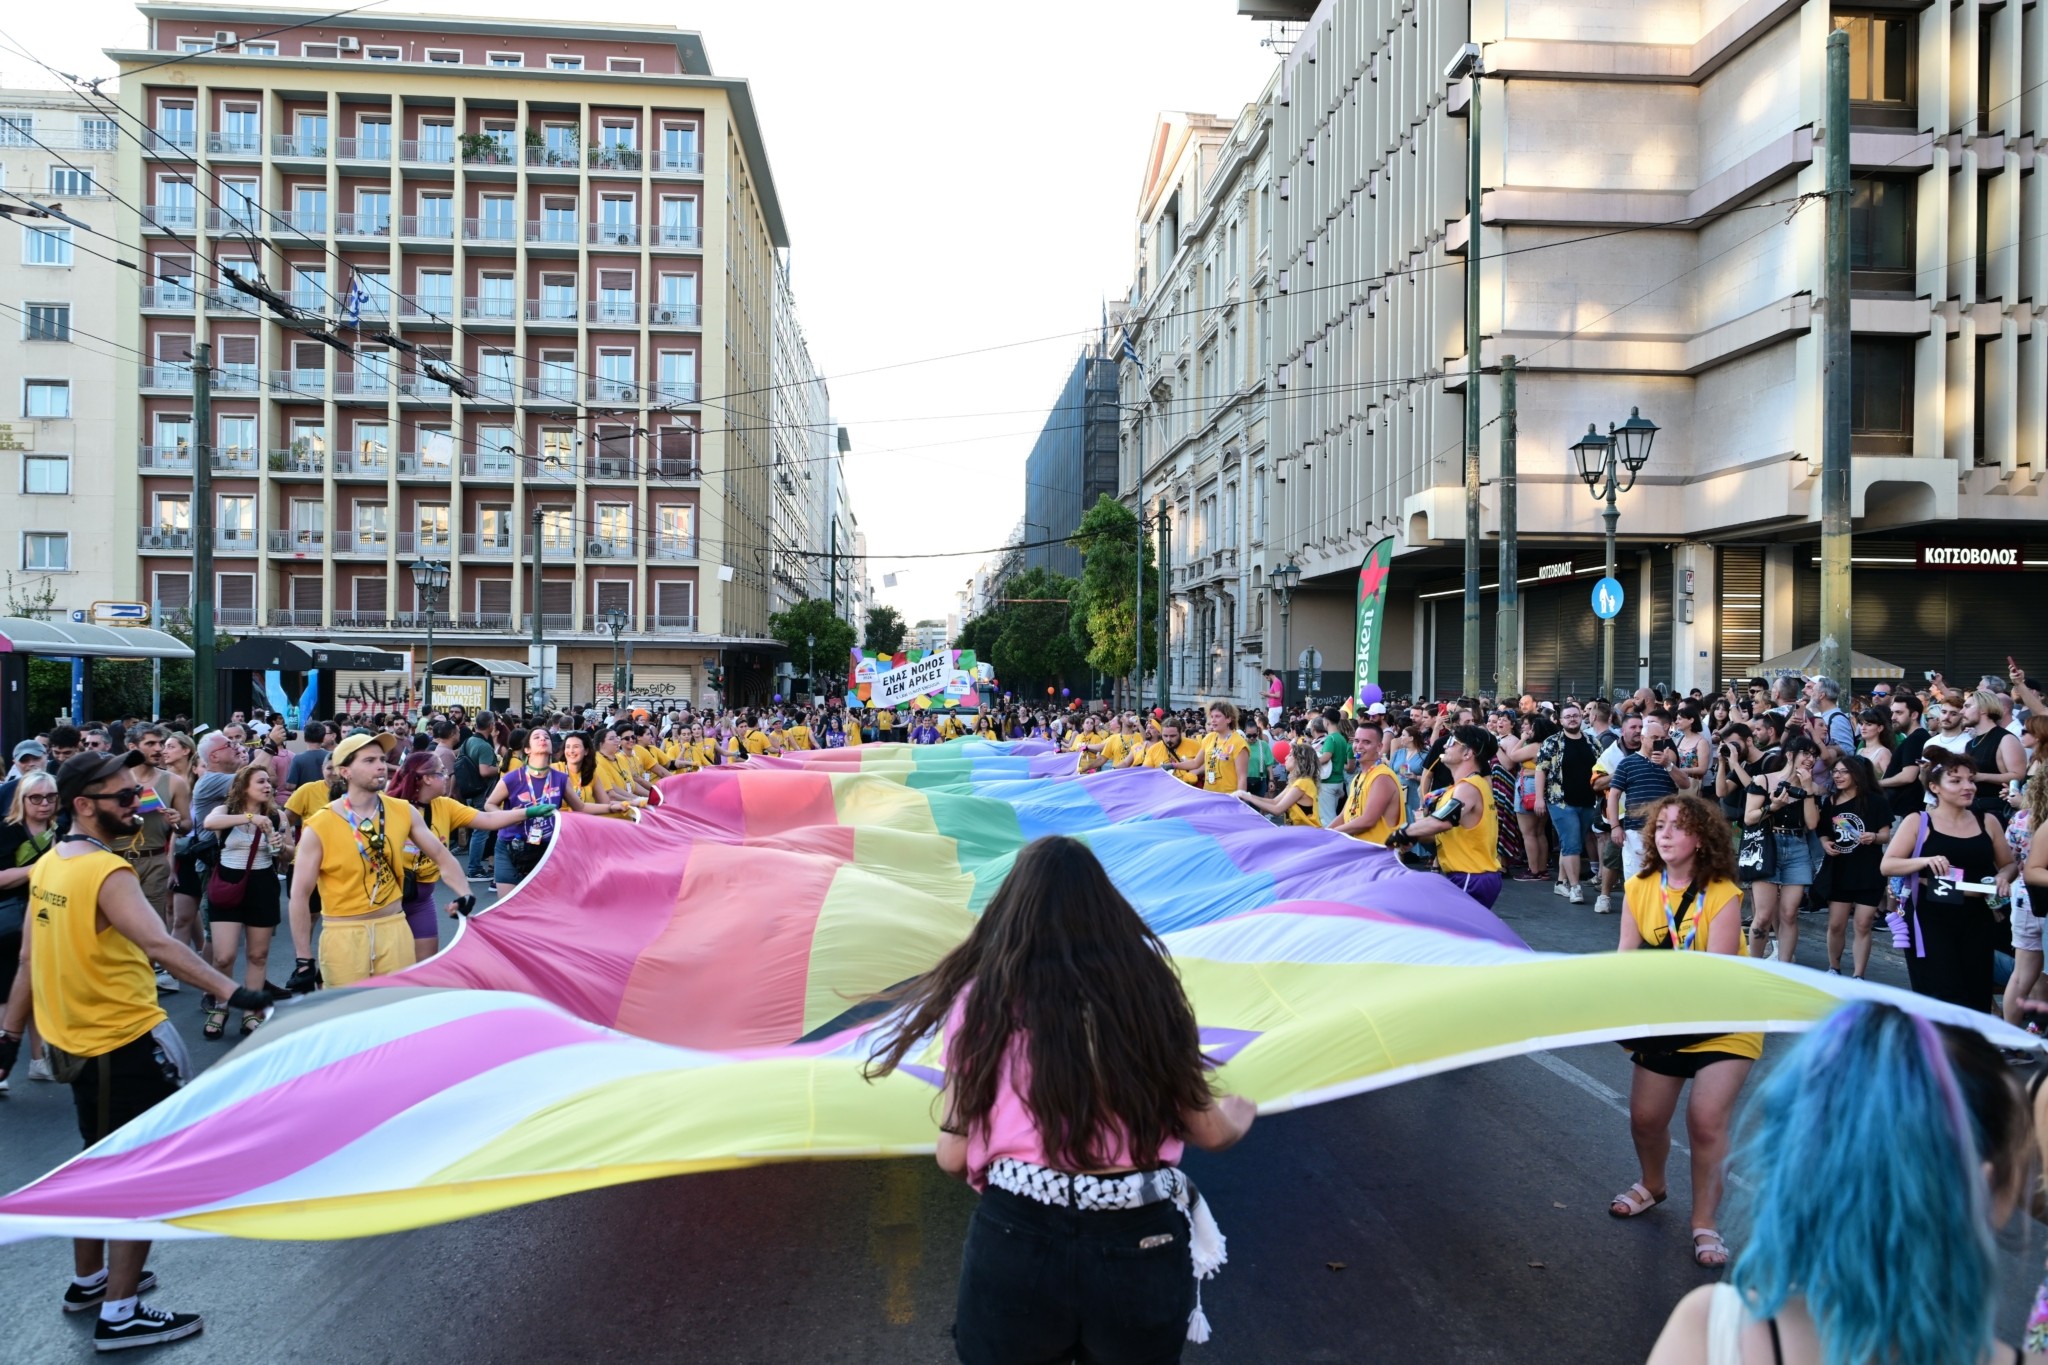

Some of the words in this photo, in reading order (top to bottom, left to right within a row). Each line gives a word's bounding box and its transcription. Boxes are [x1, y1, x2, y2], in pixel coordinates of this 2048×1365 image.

[1925, 547, 2018, 565] ΚΩΤΣΟΒΟΛΟΣ
[1539, 561, 1572, 579] ΚΩΤΣΟΒΟΛΟΣ
[883, 669, 908, 686] ΕΝΑΣ
[911, 656, 945, 676] ΝΟΜΟΣ
[886, 681, 905, 696] ΔΕΝ
[909, 669, 942, 689] ΑΡΚΕΙ
